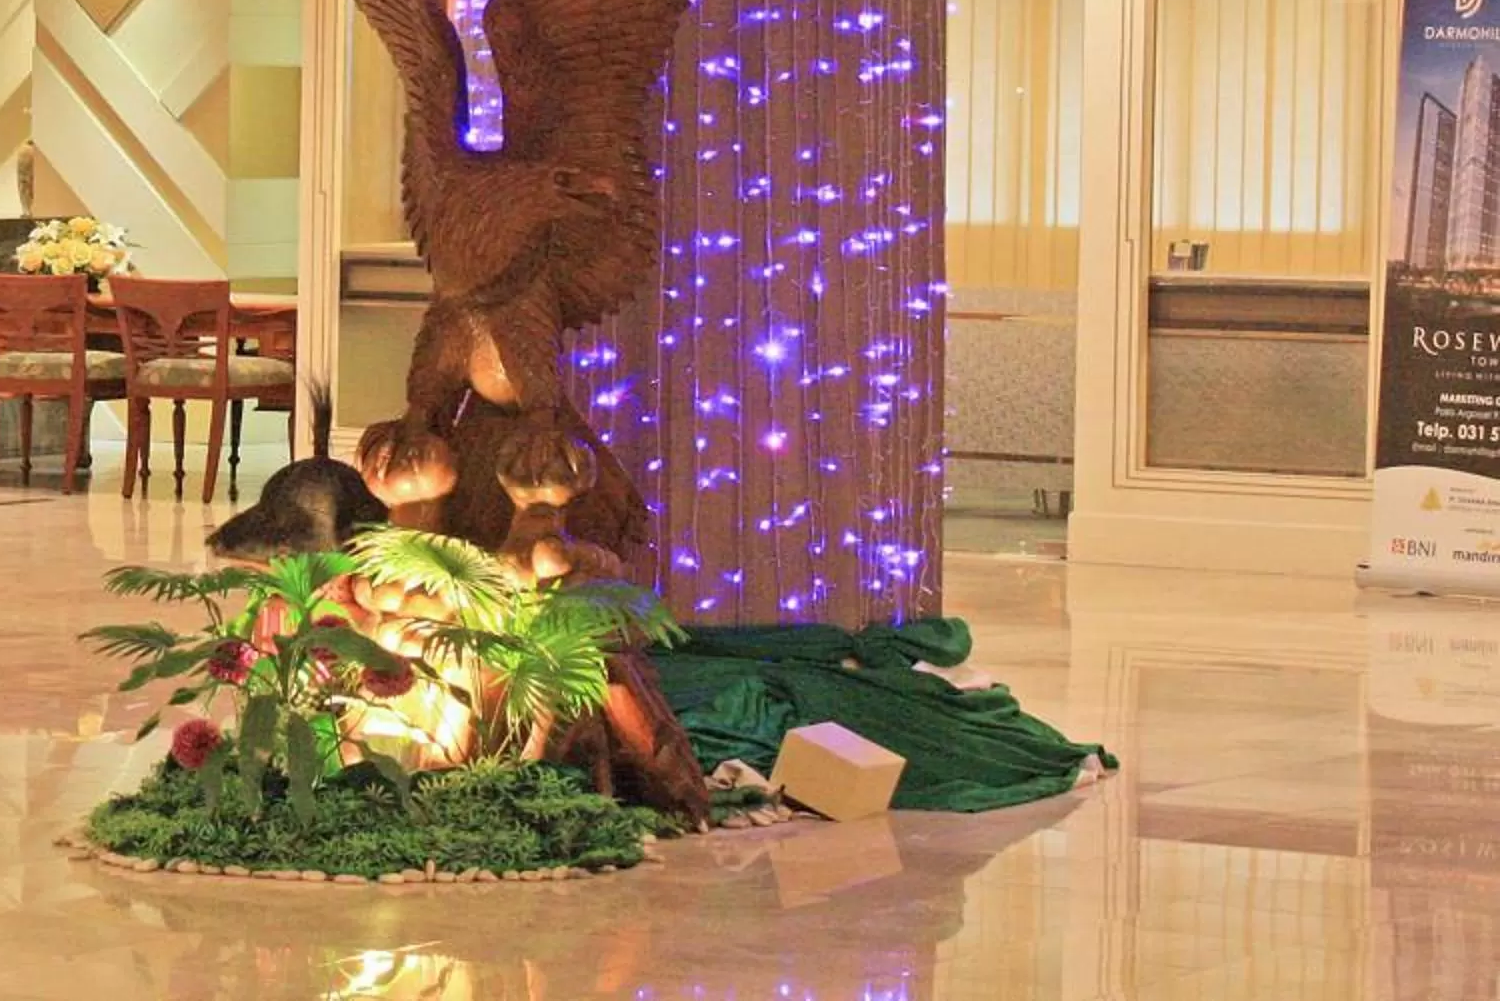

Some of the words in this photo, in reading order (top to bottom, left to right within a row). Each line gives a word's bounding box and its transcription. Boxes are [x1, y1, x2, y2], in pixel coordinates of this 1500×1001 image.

[1417, 420, 1453, 440] Telp.
[1457, 424, 1485, 440] 031
[1406, 539, 1437, 557] BNI
